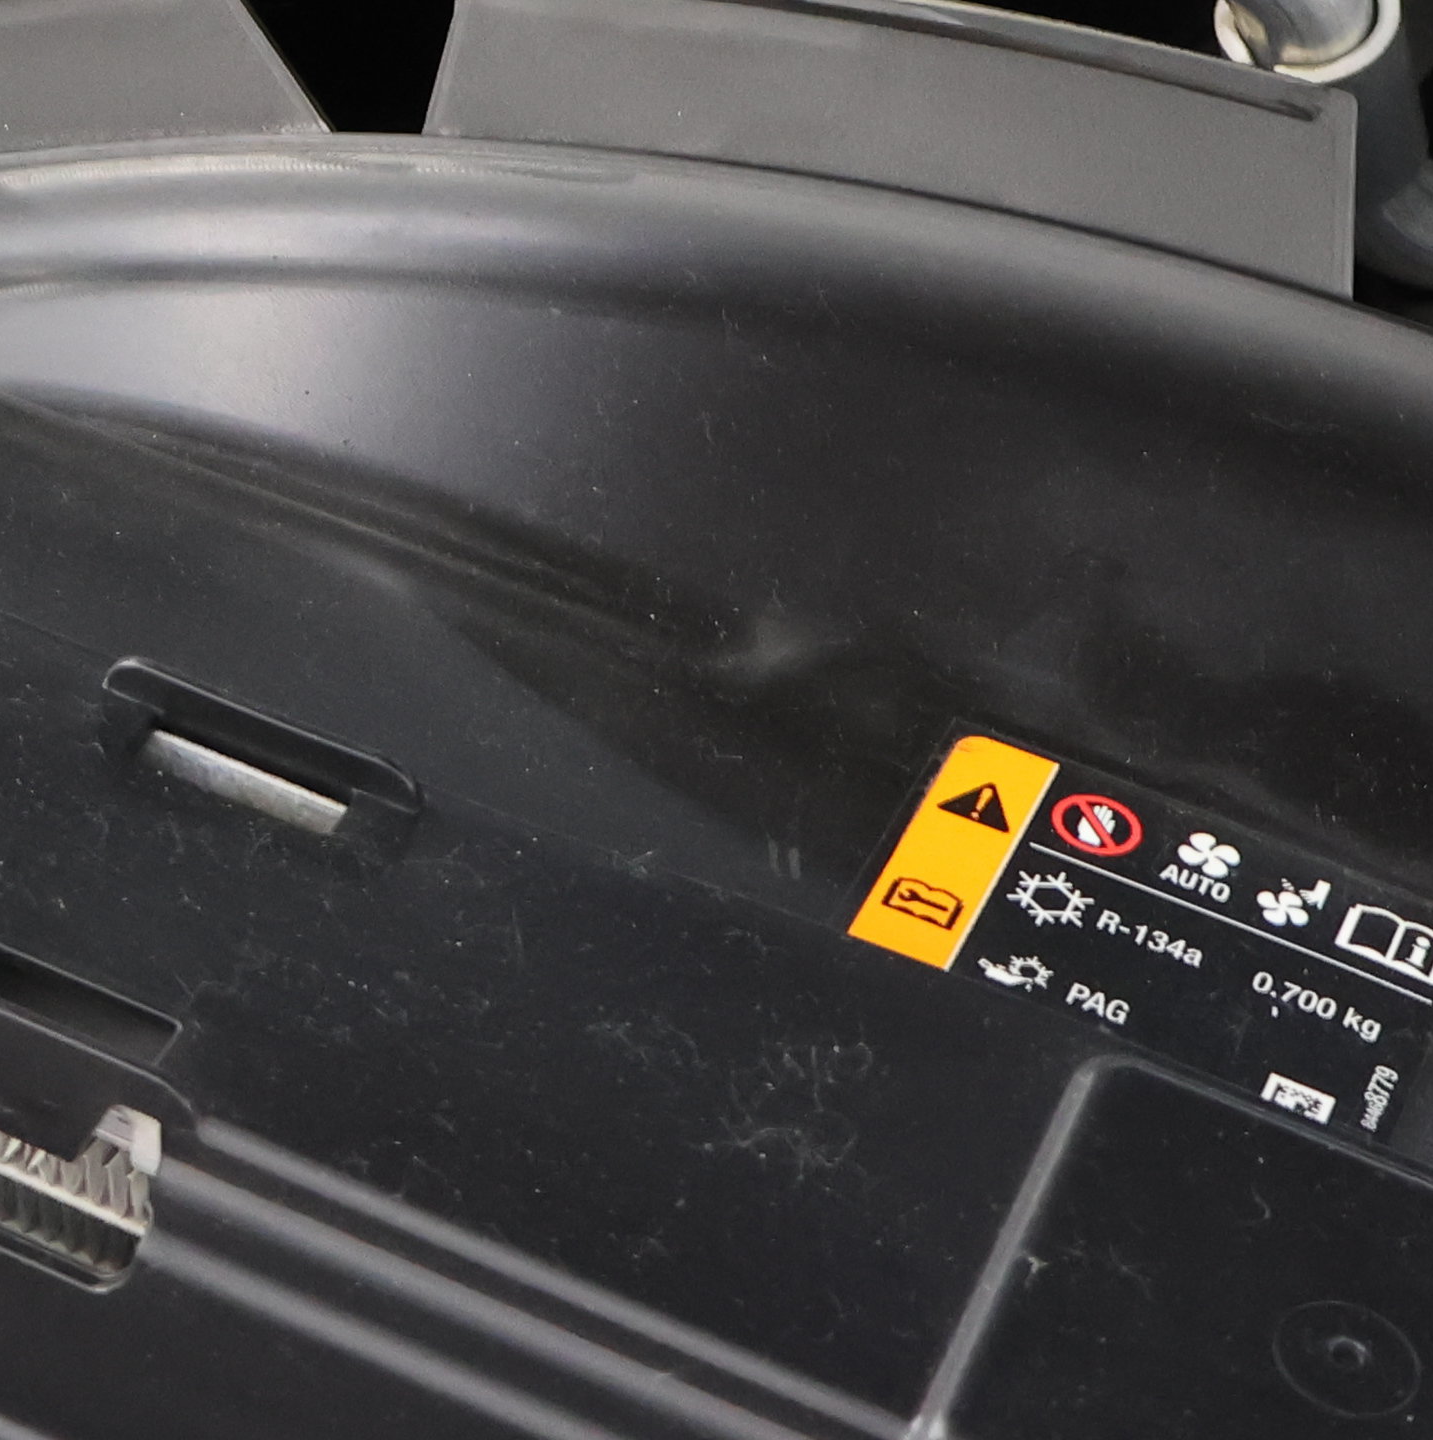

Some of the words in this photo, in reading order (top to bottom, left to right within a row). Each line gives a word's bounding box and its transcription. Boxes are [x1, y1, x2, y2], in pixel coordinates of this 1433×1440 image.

[1159, 863, 1232, 904] AUTO
[1096, 909, 1203, 968] R-134a
[1251, 969, 1337, 1022] 0.700
[1342, 1006, 1382, 1043] kg
[1065, 982, 1130, 1025] PAG
